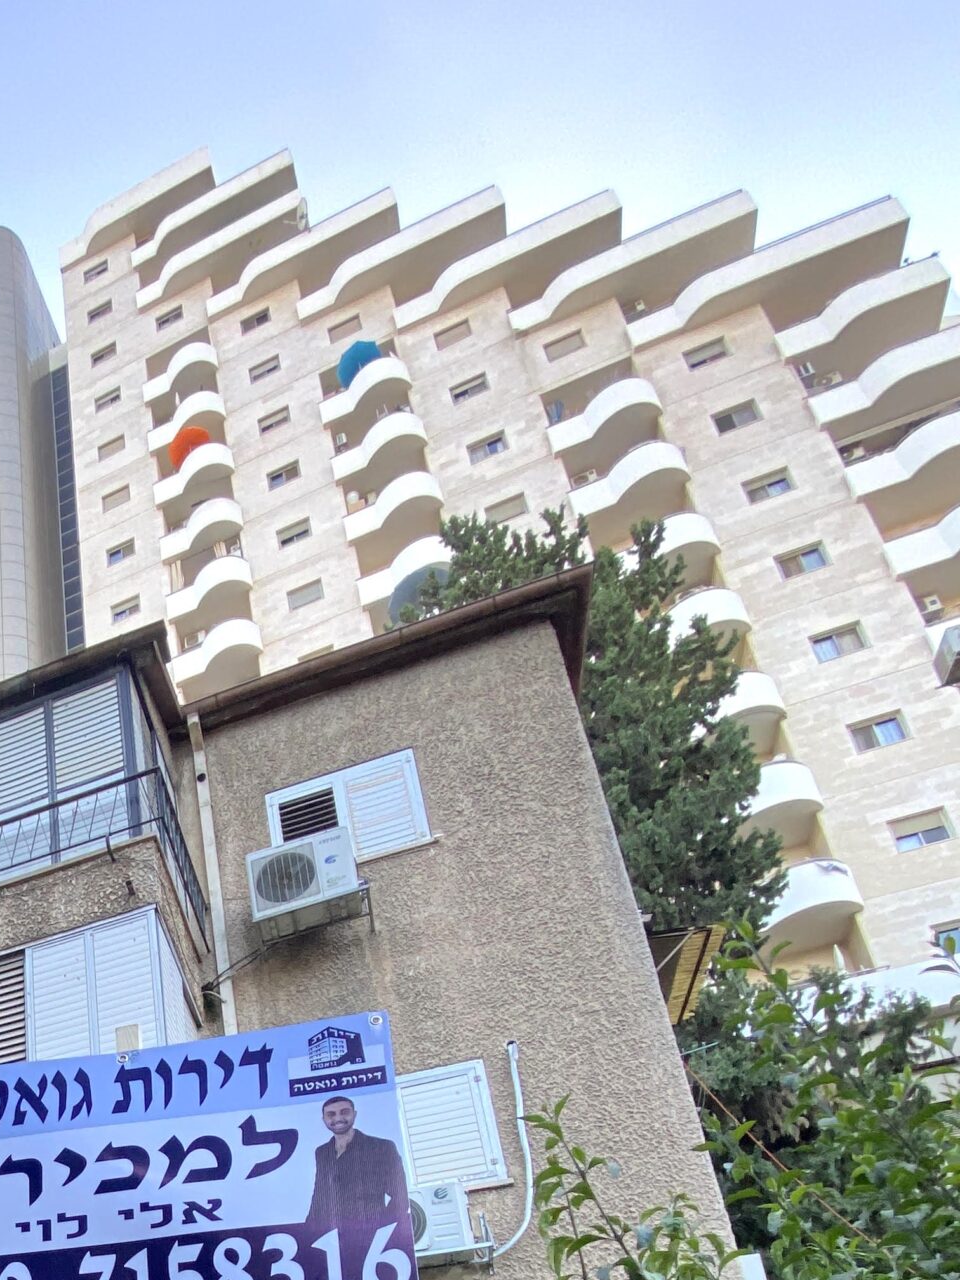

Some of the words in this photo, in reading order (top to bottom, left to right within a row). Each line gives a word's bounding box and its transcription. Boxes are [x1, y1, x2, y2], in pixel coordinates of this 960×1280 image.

[311, 1028, 356, 1044] דירות
[112, 1043, 273, 1114] דירות
[293, 1079, 337, 1092] גואטה
[342, 1071, 382, 1086] דירות
[118, 1198, 223, 1229] אלי
[15, 1212, 88, 1242] לוי
